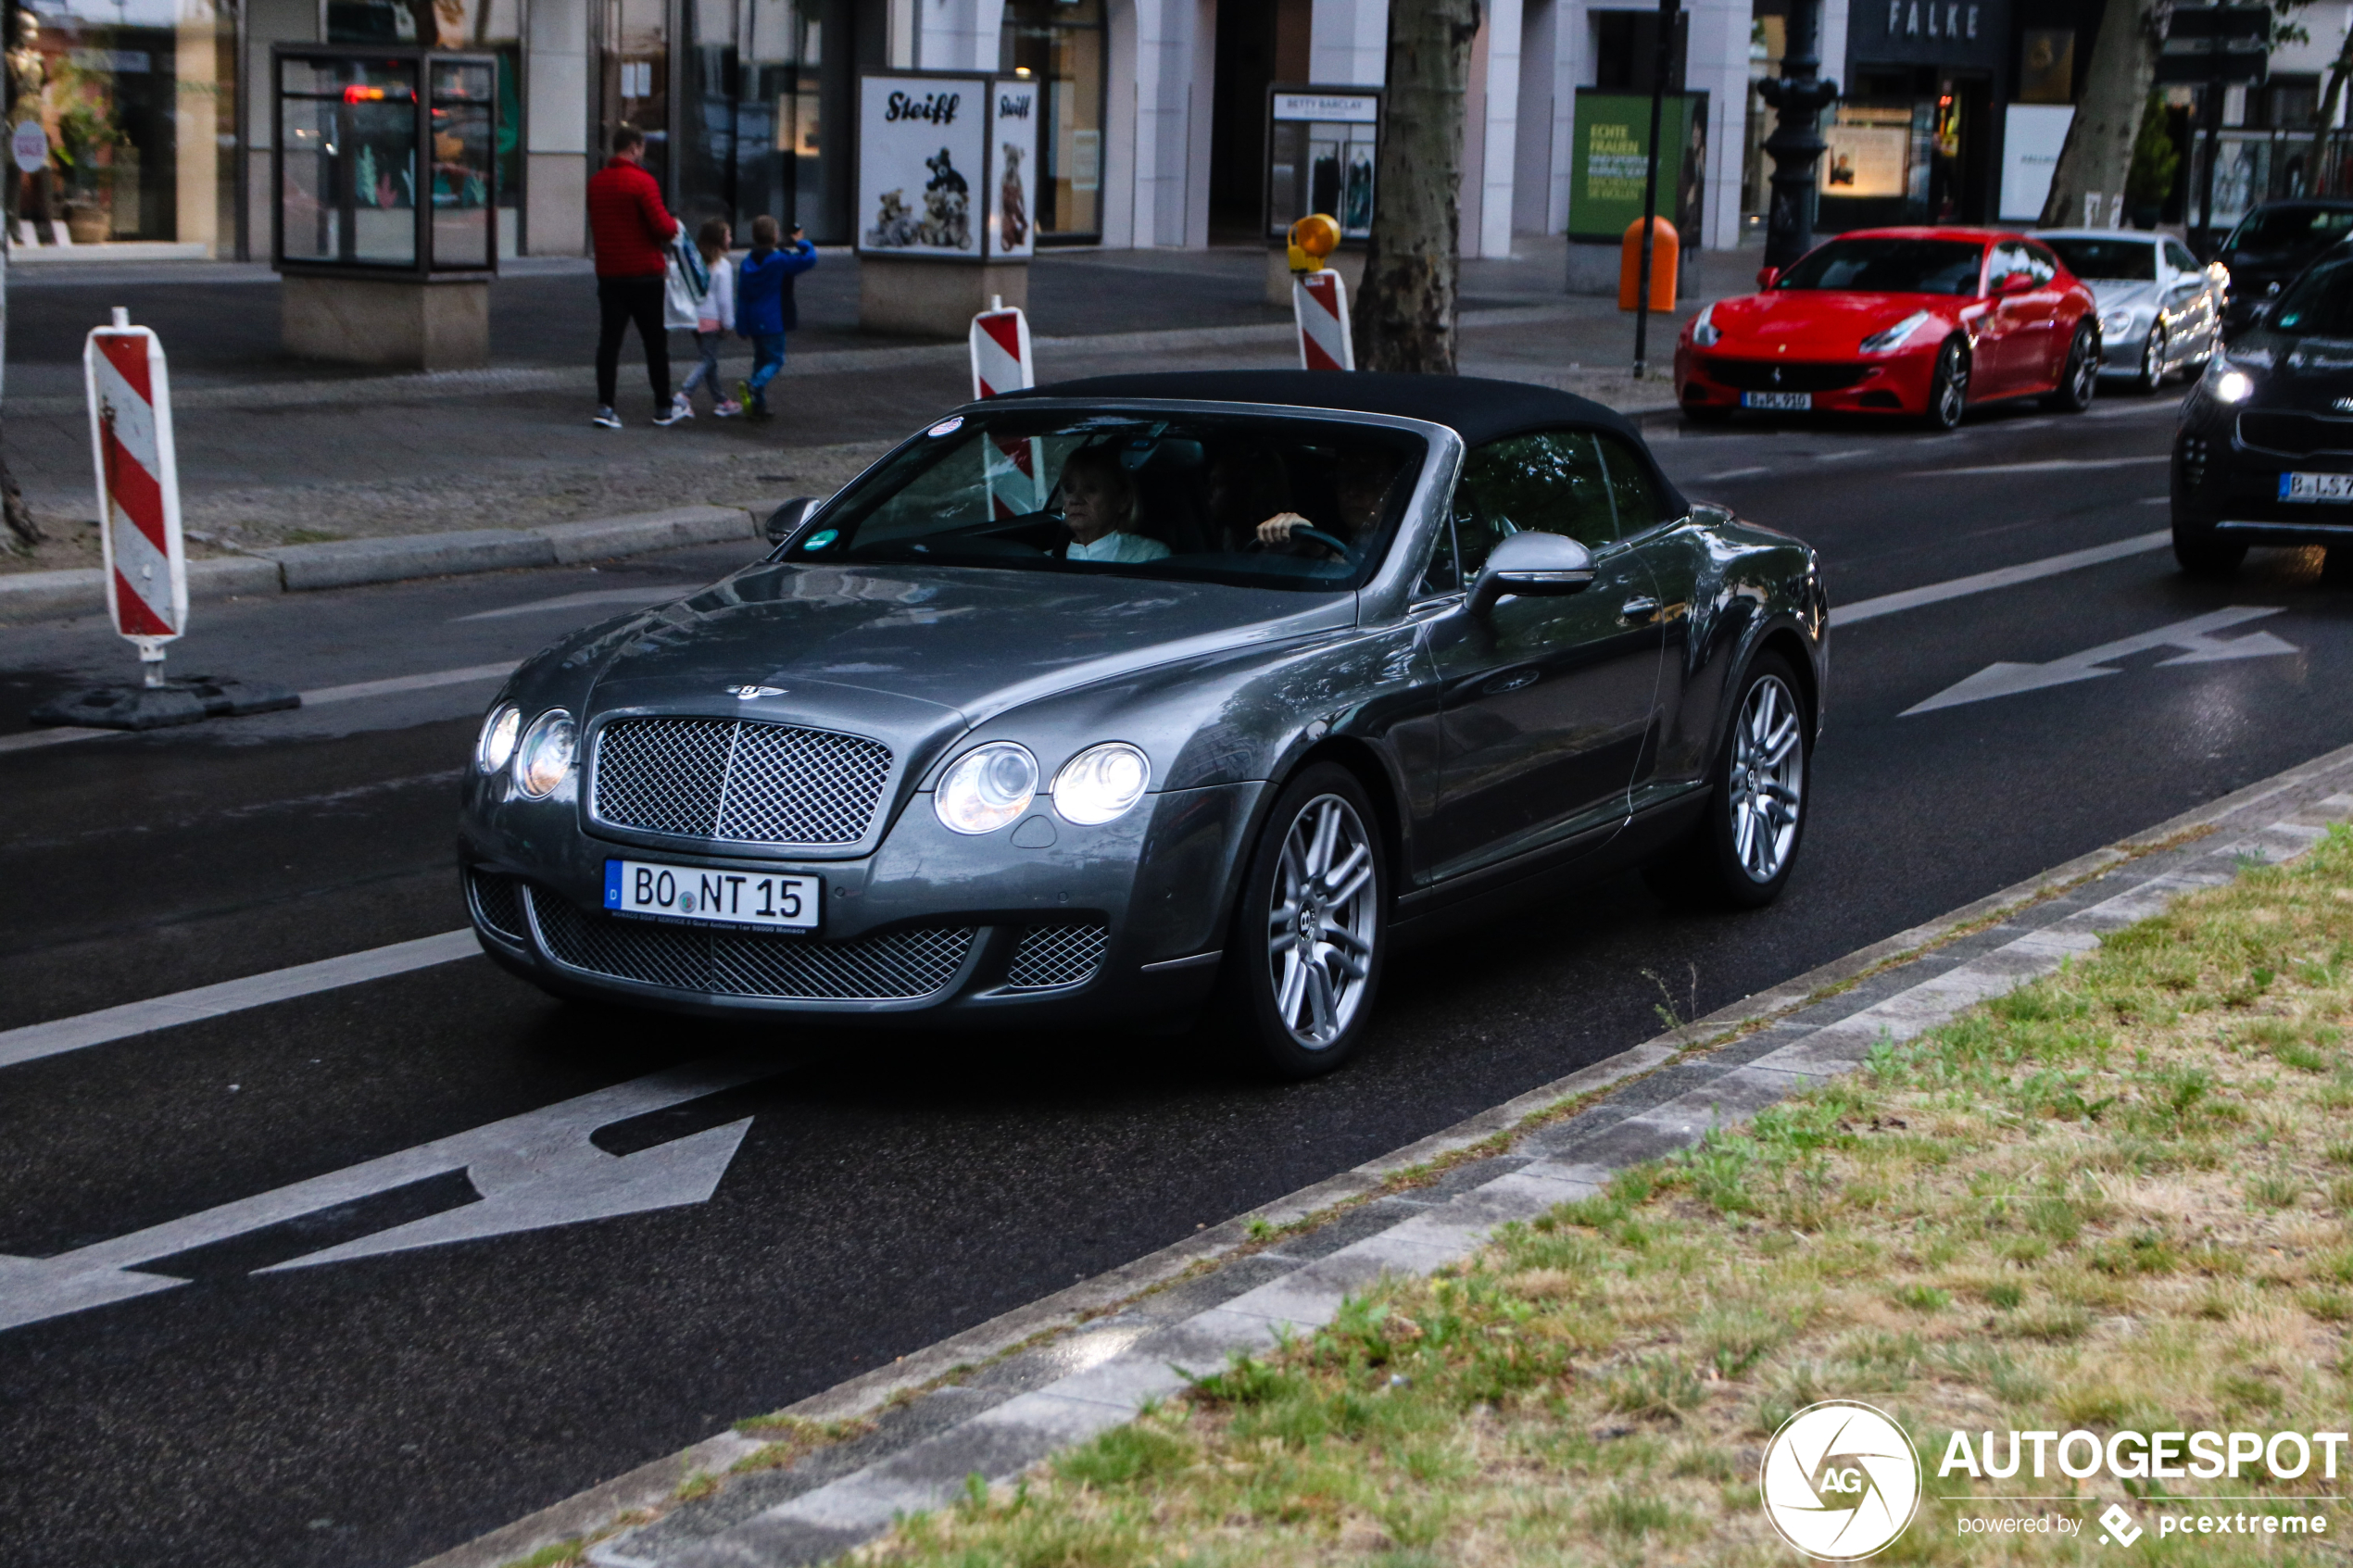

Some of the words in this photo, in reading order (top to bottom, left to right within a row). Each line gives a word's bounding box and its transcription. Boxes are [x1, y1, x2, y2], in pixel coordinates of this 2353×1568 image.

[1889, 0, 1980, 38] FALKE
[886, 91, 960, 124] Steiff
[999, 95, 1031, 119] Steiff
[1591, 124, 1629, 138] ECHTE
[1590, 139, 1639, 154] FRAUEN
[2291, 476, 2302, 493] B
[2315, 474, 2340, 495] LS
[610, 888, 617, 900] D
[635, 867, 675, 907] BO
[701, 873, 747, 913] NT
[756, 879, 802, 917] 15
[611, 910, 638, 920] MONACO
[657, 916, 686, 925] SERVICE
[692, 918, 708, 927] Quai
[710, 922, 736, 930] Antoine
[776, 926, 806, 935] Monaco
